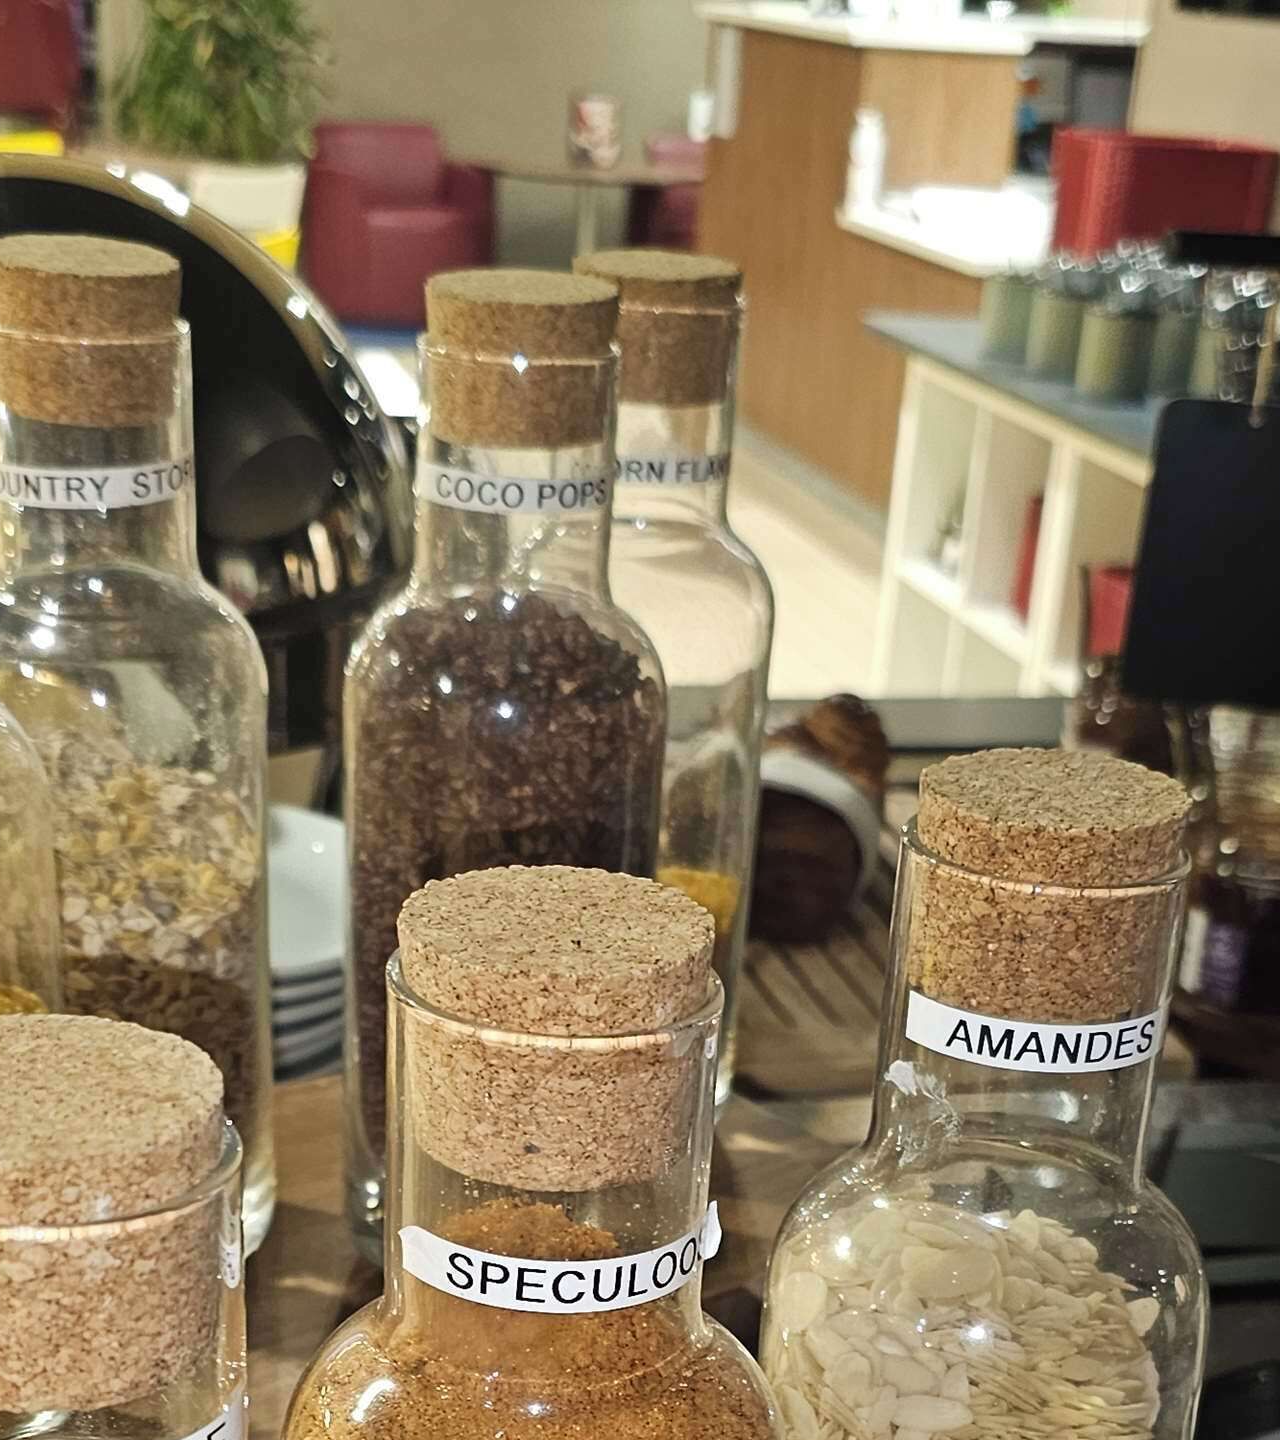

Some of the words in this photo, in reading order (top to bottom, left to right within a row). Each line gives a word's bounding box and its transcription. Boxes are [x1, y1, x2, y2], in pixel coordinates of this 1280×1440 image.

[436, 474, 524, 509] COCO
[537, 478, 607, 510] POPS
[945, 1018, 1156, 1065] AMANDES
[446, 1234, 703, 1305] SPECULOO
